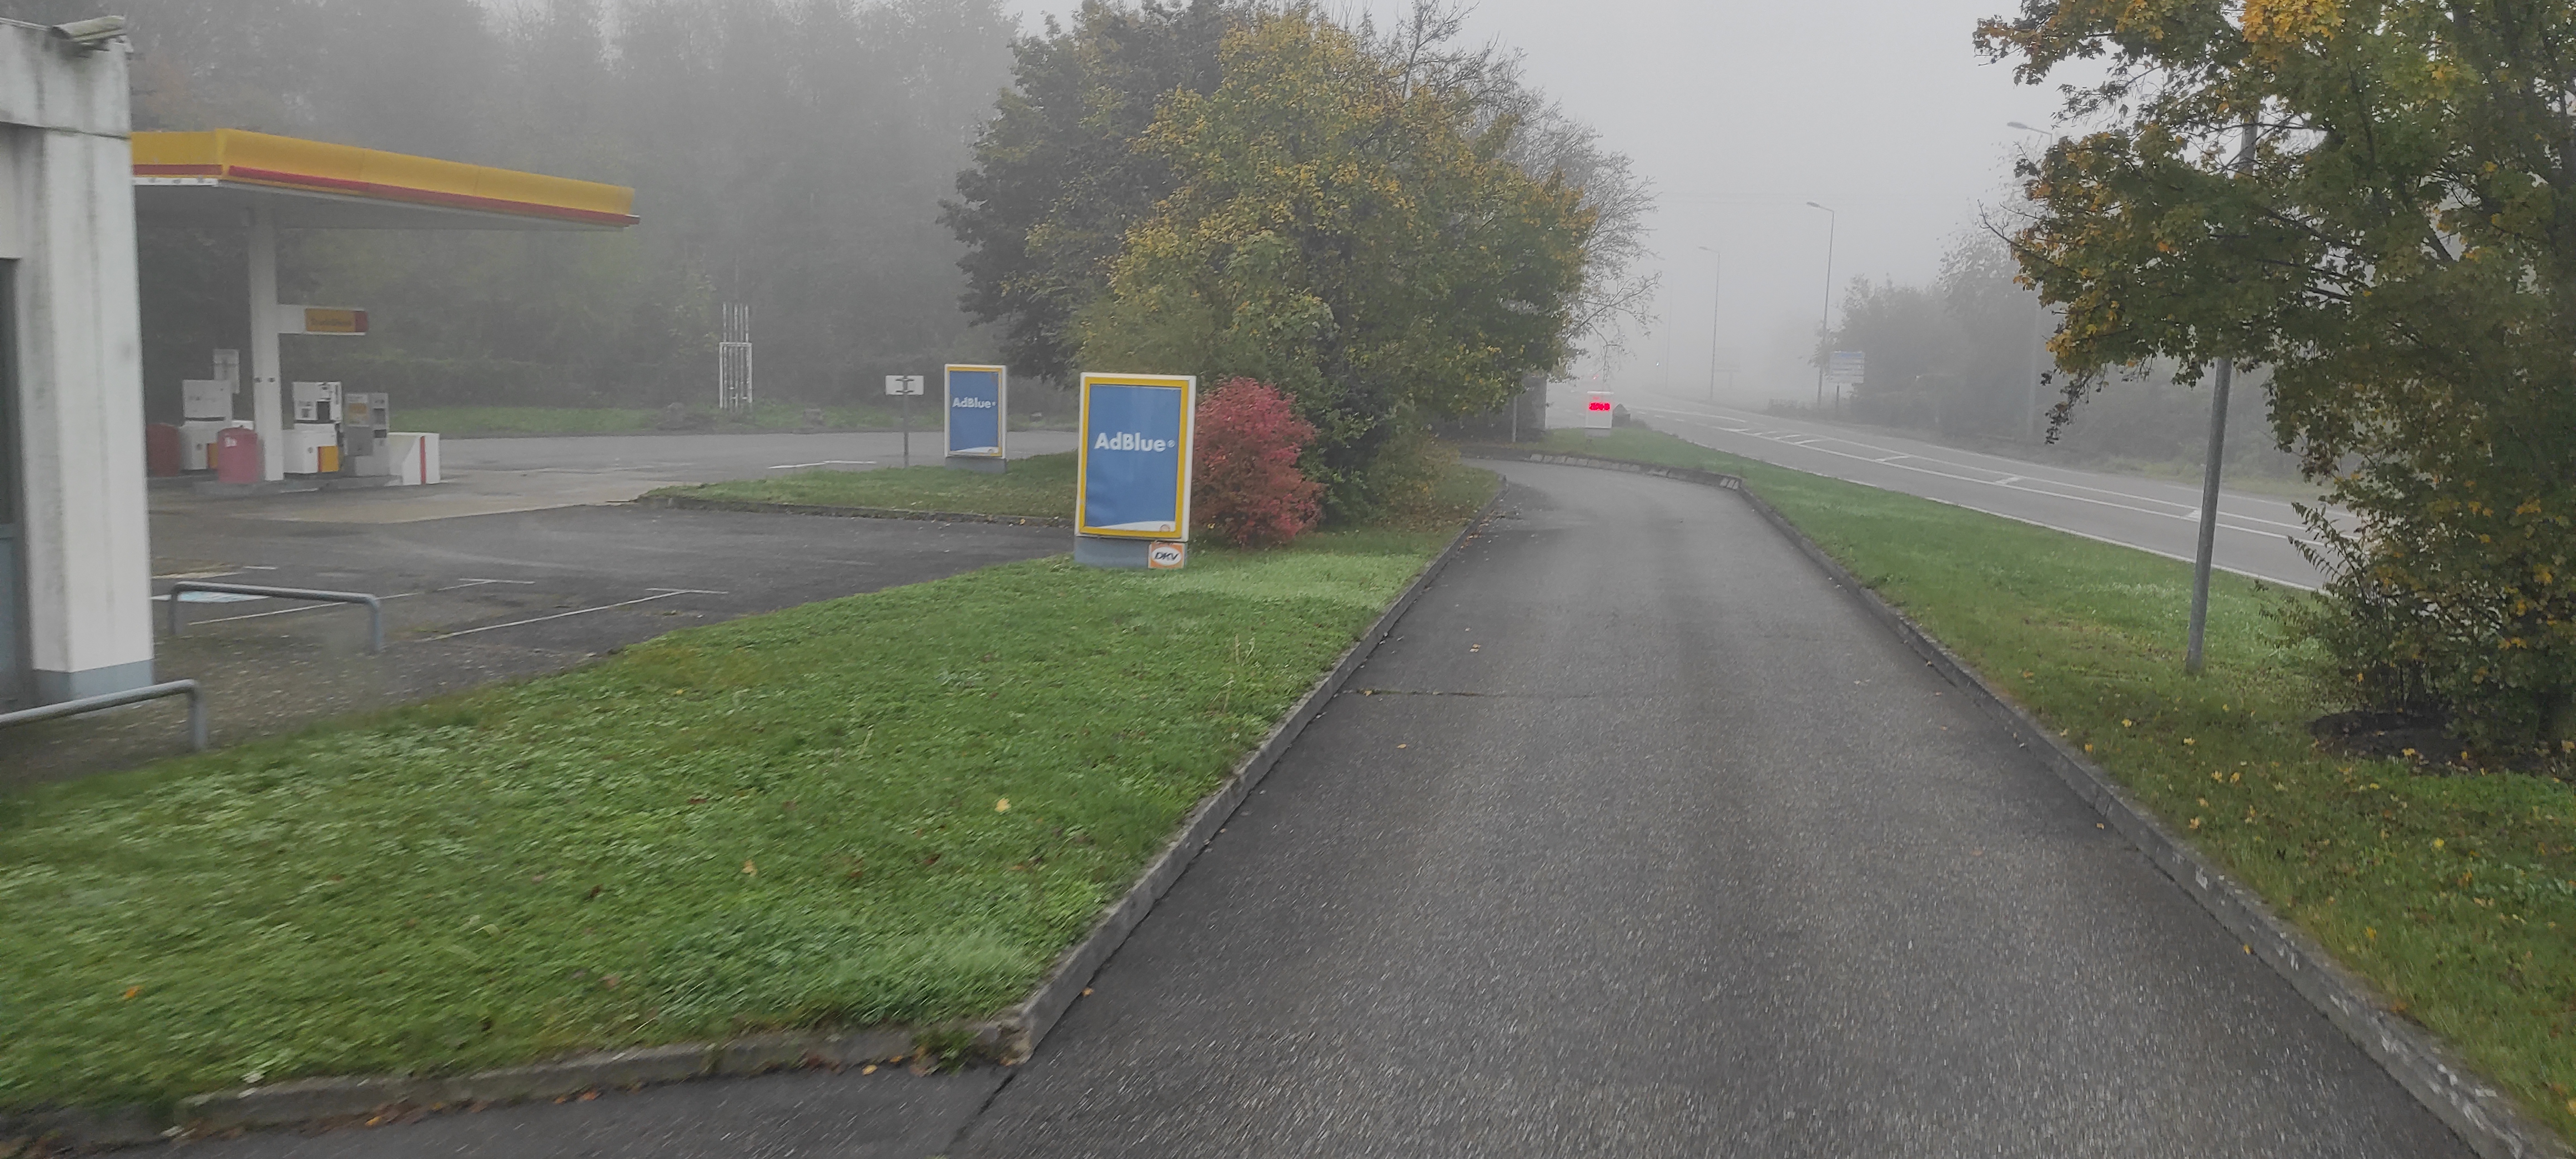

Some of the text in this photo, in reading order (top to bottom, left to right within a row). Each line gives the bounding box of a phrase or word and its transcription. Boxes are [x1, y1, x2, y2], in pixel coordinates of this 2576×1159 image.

[952, 397, 991, 409] AdBlue
[1094, 431, 1166, 452] AdBlue
[1154, 552, 1180, 561] DKV
